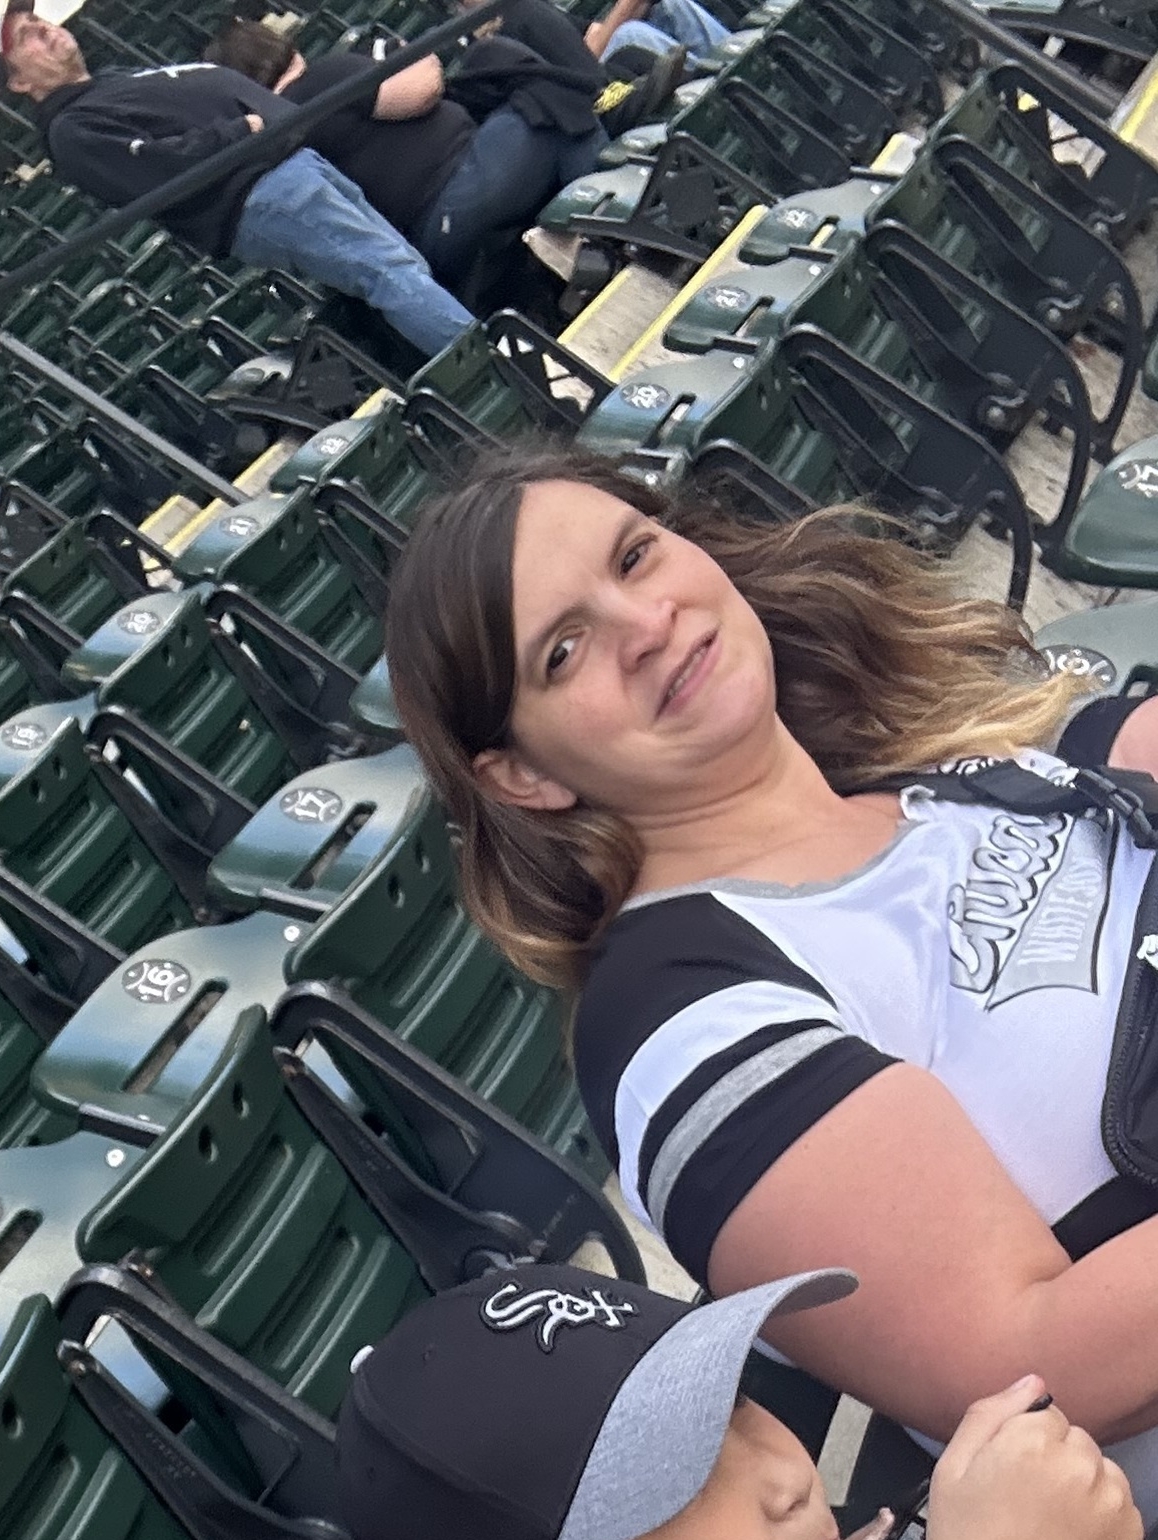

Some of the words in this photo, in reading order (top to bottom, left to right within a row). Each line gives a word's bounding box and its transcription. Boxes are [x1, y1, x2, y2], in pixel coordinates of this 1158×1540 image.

[633, 384, 659, 408] 20
[128, 612, 151, 633] 20
[294, 792, 324, 818] 17
[138, 967, 172, 999] 16
